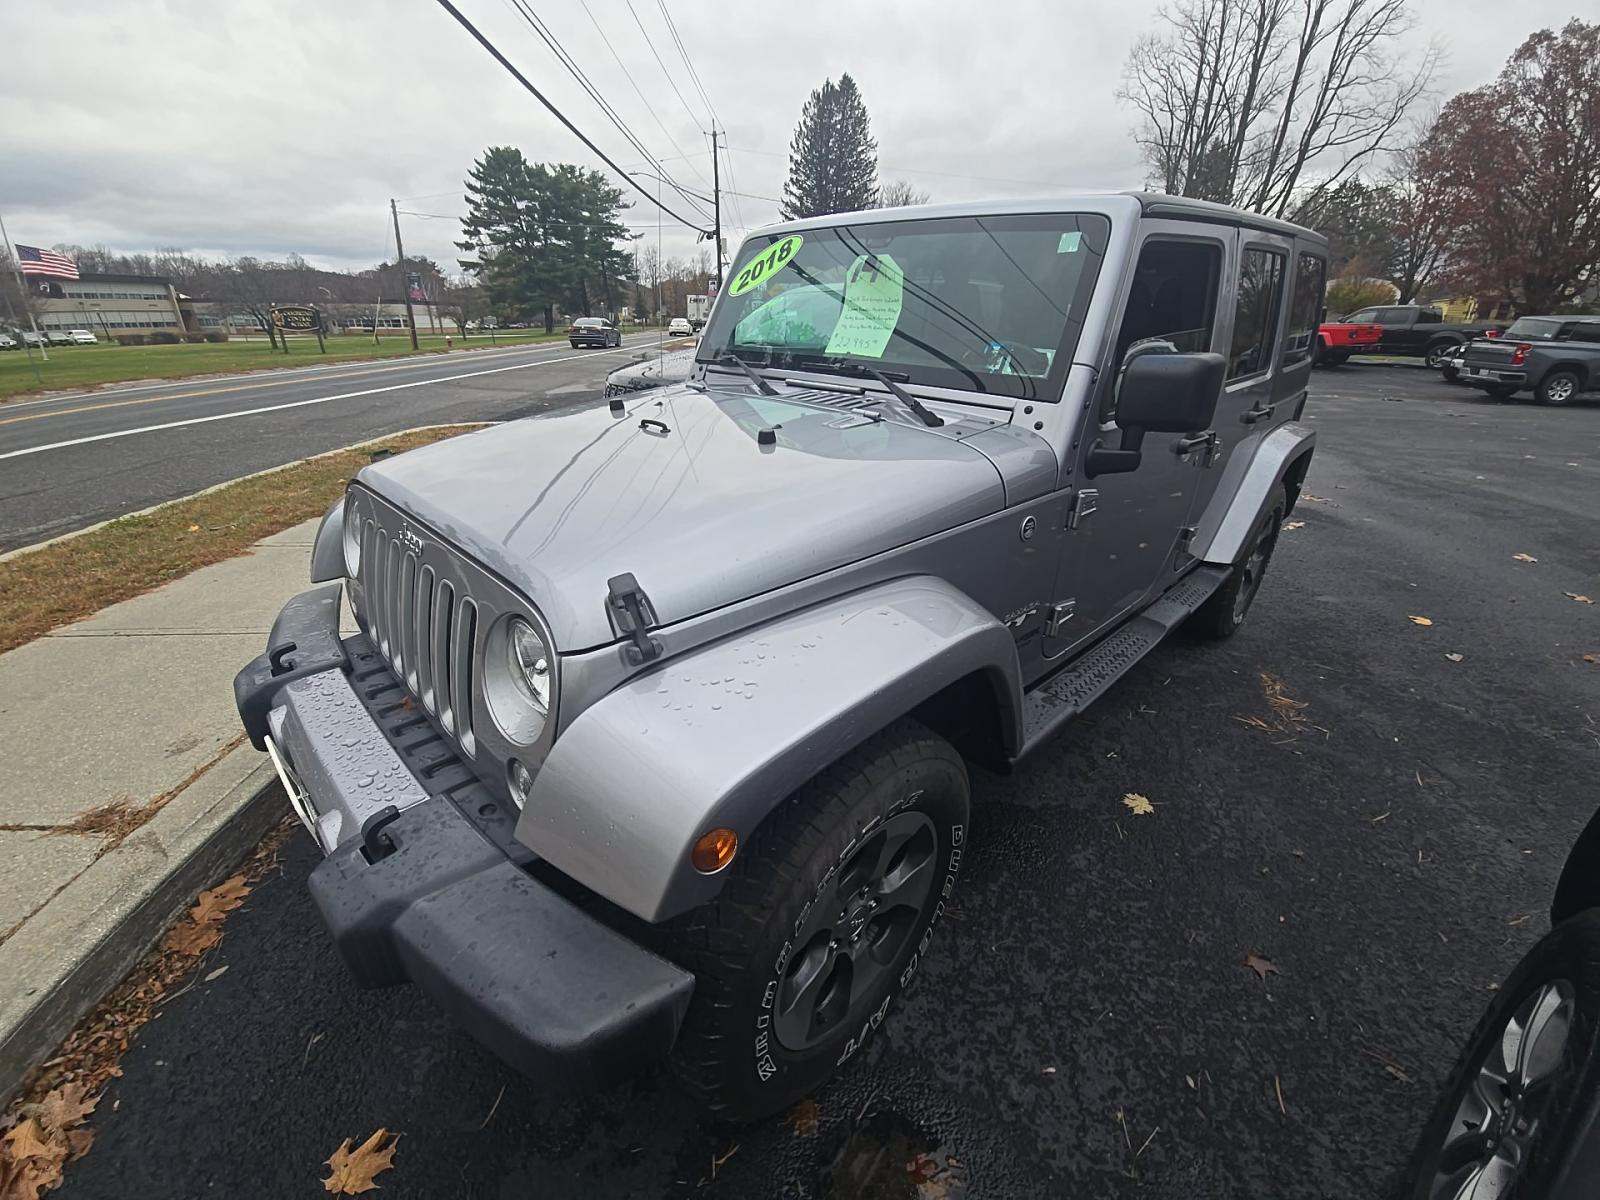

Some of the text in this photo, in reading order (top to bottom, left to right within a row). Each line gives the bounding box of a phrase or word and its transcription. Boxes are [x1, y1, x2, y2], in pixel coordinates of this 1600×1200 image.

[737, 239, 793, 292] 2018
[754, 790, 925, 1082] BRIDGE
[900, 824, 964, 988] DUELER
